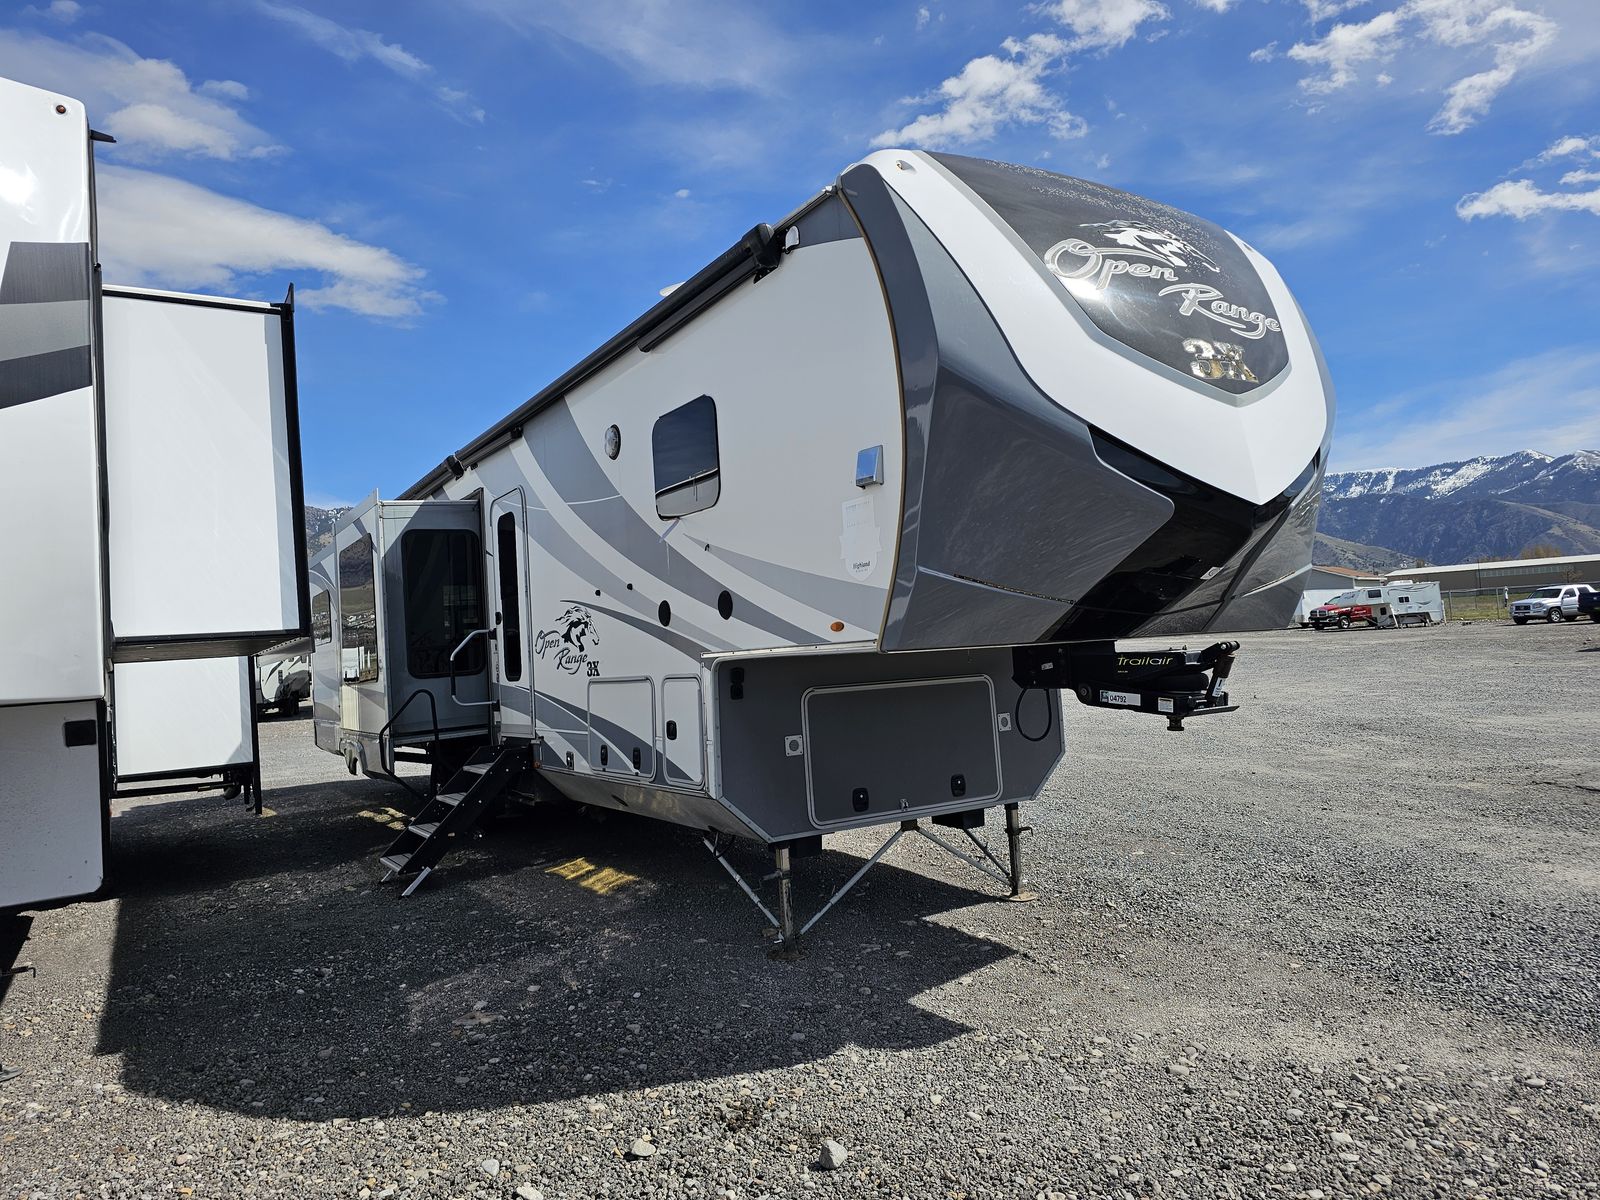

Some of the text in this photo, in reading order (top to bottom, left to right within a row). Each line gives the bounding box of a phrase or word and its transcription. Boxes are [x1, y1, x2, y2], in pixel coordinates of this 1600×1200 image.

[1044, 238, 1179, 290] Open
[1158, 282, 1281, 339] Range
[535, 630, 560, 659] Open
[553, 647, 588, 675] Range
[586, 660, 600, 677] 3X
[1117, 655, 1173, 666] Trailair
